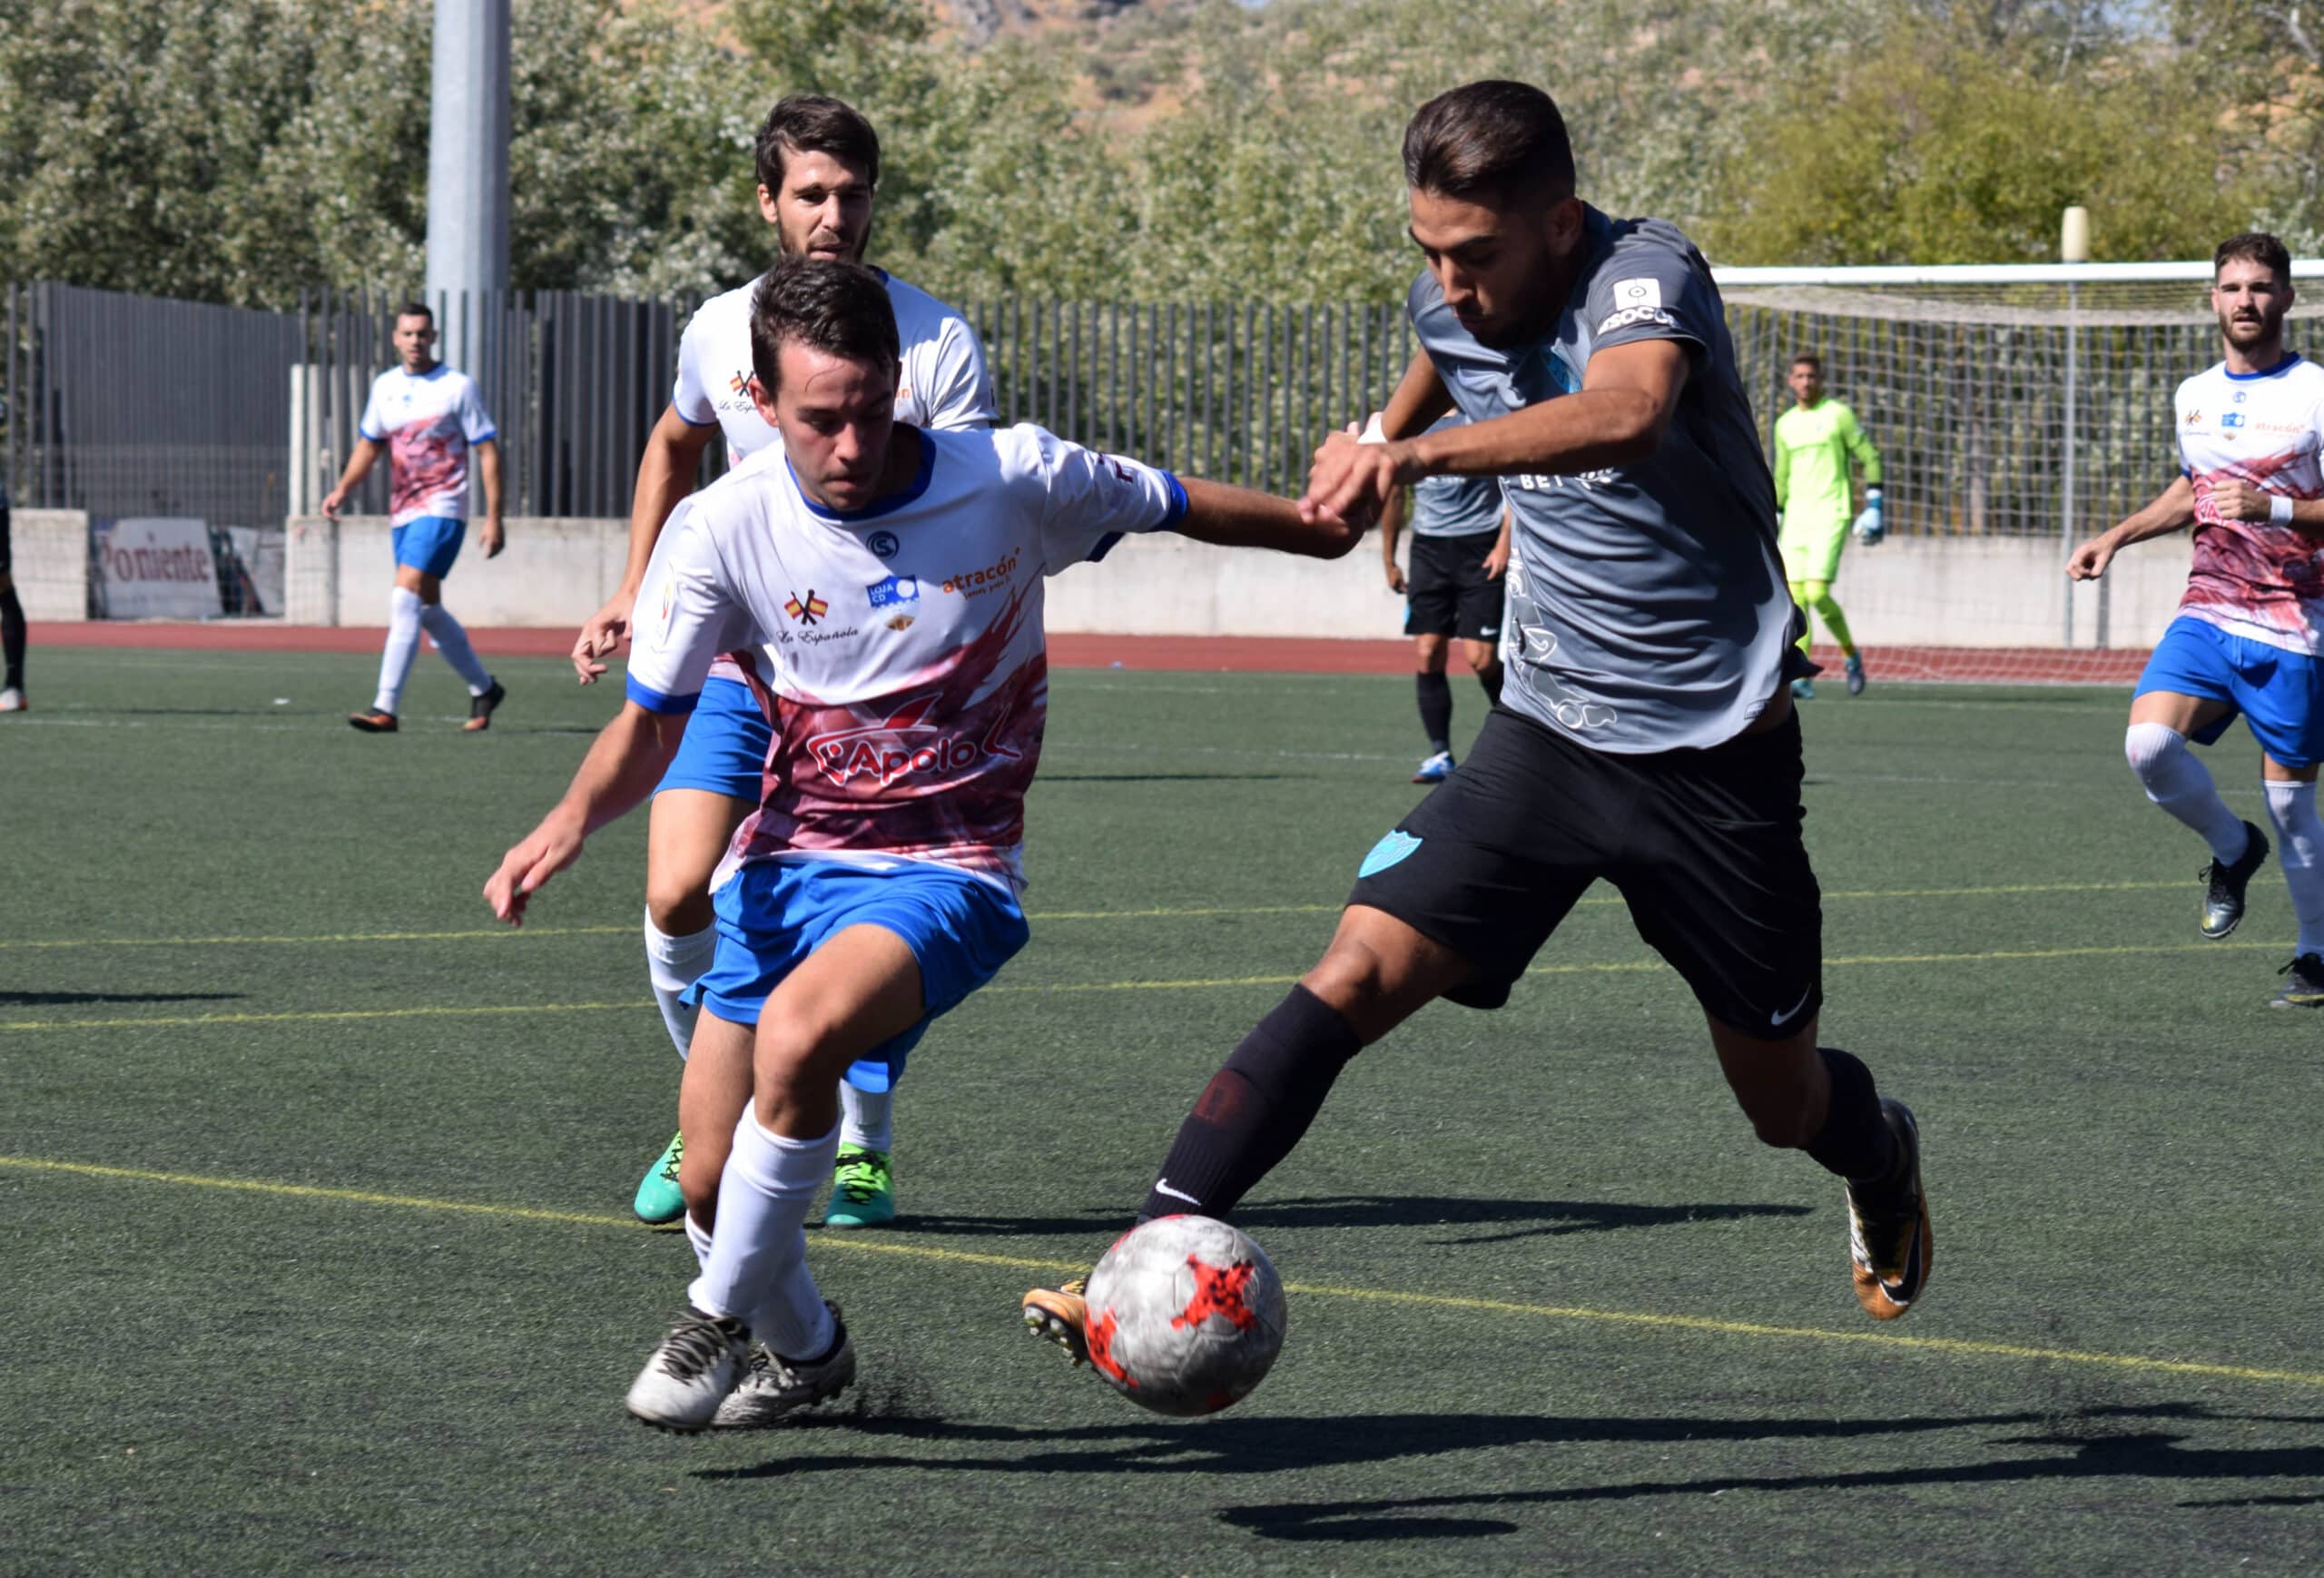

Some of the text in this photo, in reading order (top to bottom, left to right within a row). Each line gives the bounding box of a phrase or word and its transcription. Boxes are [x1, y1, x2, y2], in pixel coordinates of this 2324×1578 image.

[942, 555, 1018, 594] atracón
[871, 584, 893, 596] LOJA
[872, 594, 886, 603] CD
[776, 630, 793, 644] La
